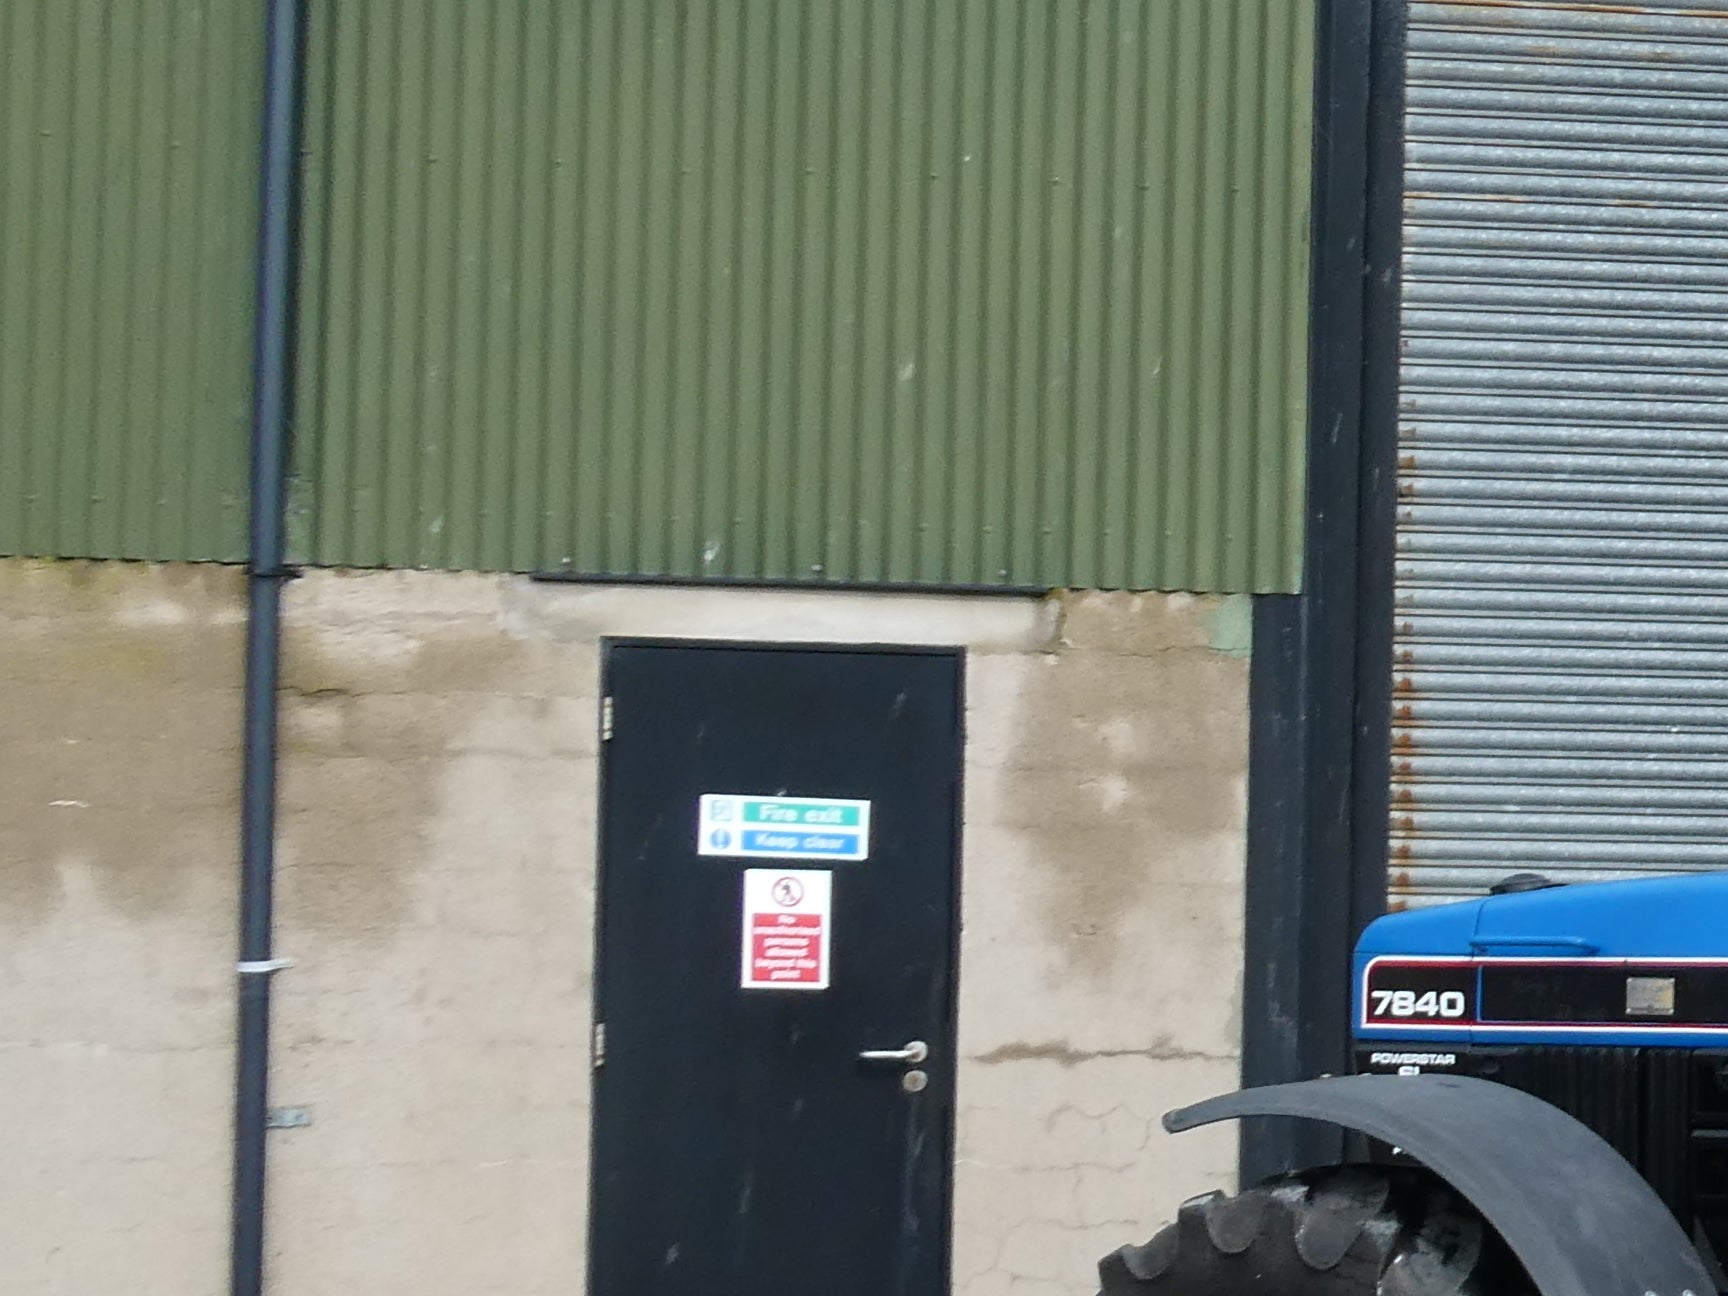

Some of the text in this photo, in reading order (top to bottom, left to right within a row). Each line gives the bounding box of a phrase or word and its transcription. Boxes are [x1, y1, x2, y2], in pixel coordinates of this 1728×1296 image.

[760, 803, 843, 824] Fire exit
[1371, 990, 1465, 1017] 7840
[1370, 1052, 1456, 1065] POWERSTAR
